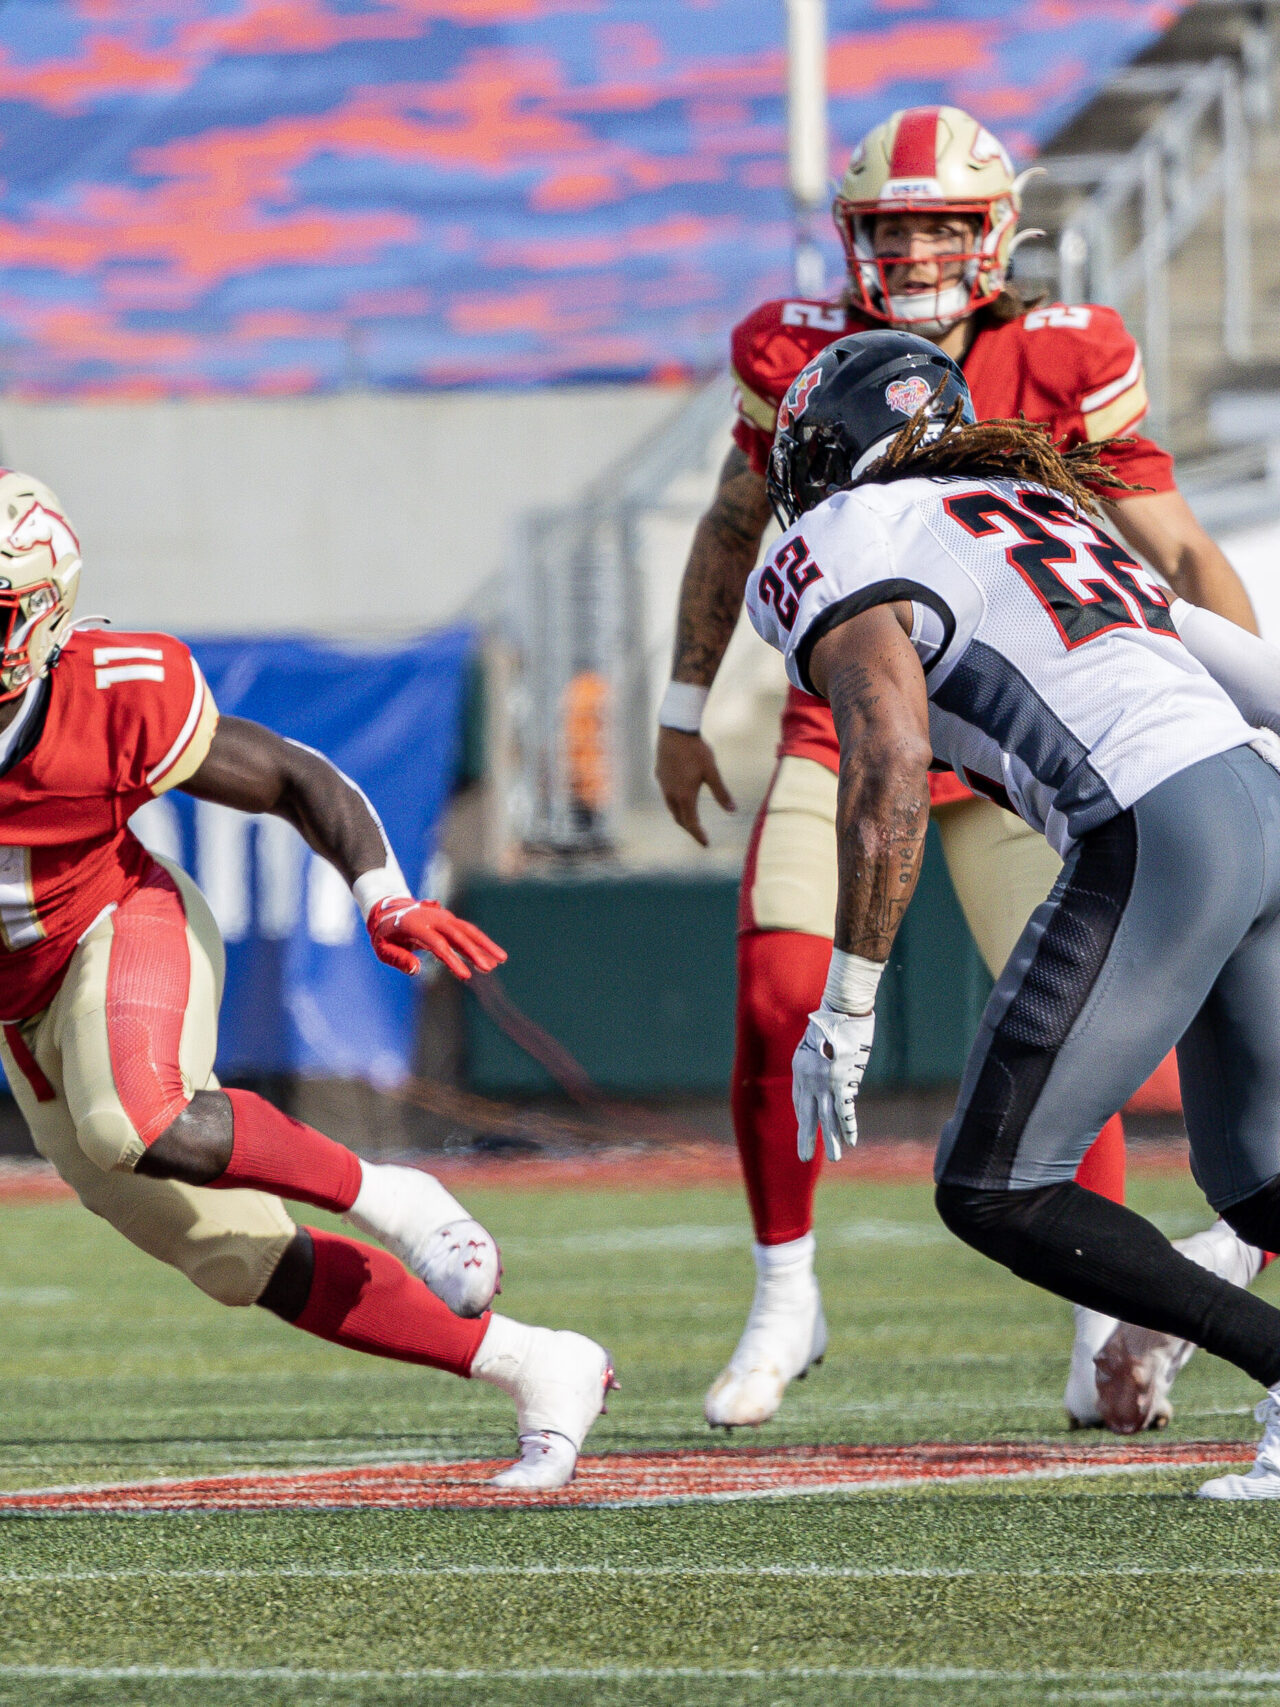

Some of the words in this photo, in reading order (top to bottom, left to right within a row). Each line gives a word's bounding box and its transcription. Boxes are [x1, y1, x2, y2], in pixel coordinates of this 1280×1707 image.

[781, 303, 847, 332] 2
[1023, 306, 1092, 331] 2
[758, 535, 824, 632] 22
[943, 490, 1182, 651] 22
[92, 647, 165, 689] 11
